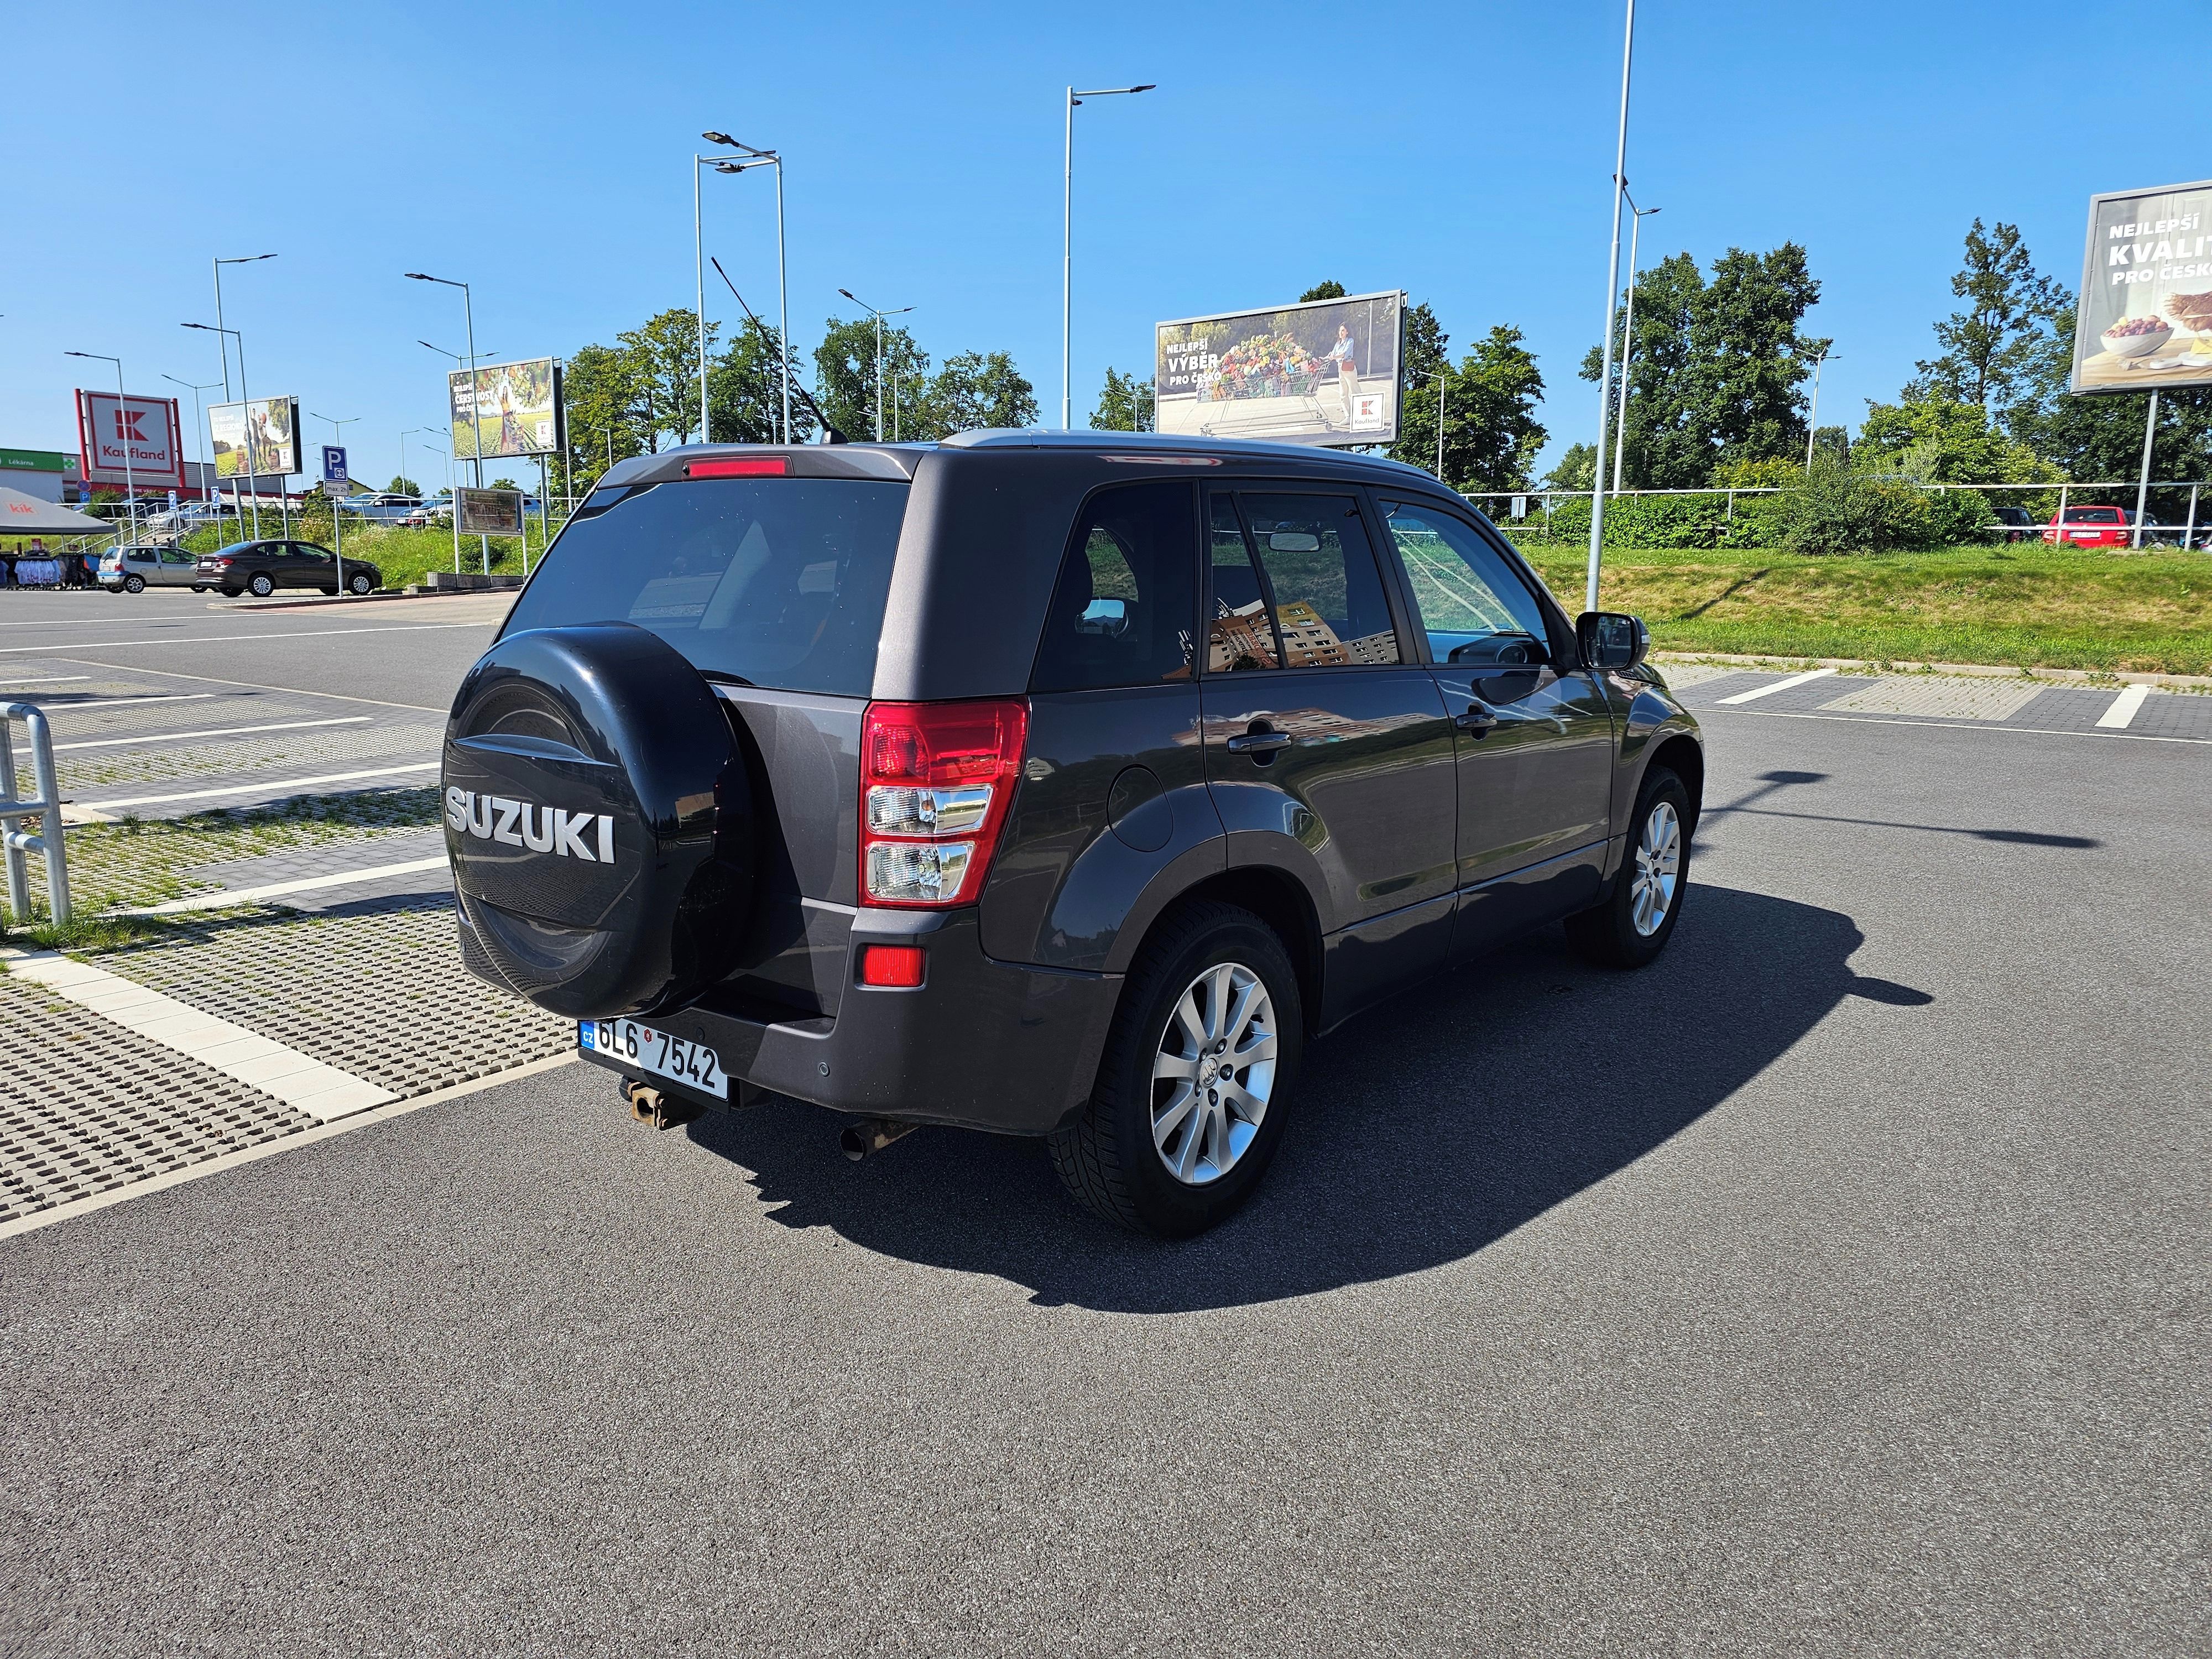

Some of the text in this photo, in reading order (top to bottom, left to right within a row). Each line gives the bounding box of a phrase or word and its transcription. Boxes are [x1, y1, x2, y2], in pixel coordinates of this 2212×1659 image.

[2109, 212, 2200, 239] NEJLEPŠÍ
[2112, 263, 2212, 285] PRO ČESK
[1166, 338, 1208, 354] NEJLEPŠÍ
[1168, 351, 1218, 373] VÝBĚR
[1170, 371, 1222, 386] PRO ČESKO
[103, 445, 165, 461] Kaufland
[328, 451, 341, 469] P
[212, 489, 218, 503] P
[446, 786, 615, 864] SUZUKI
[583, 1031, 593, 1044] CZ
[599, 1022, 715, 1089] 6L6 7542
